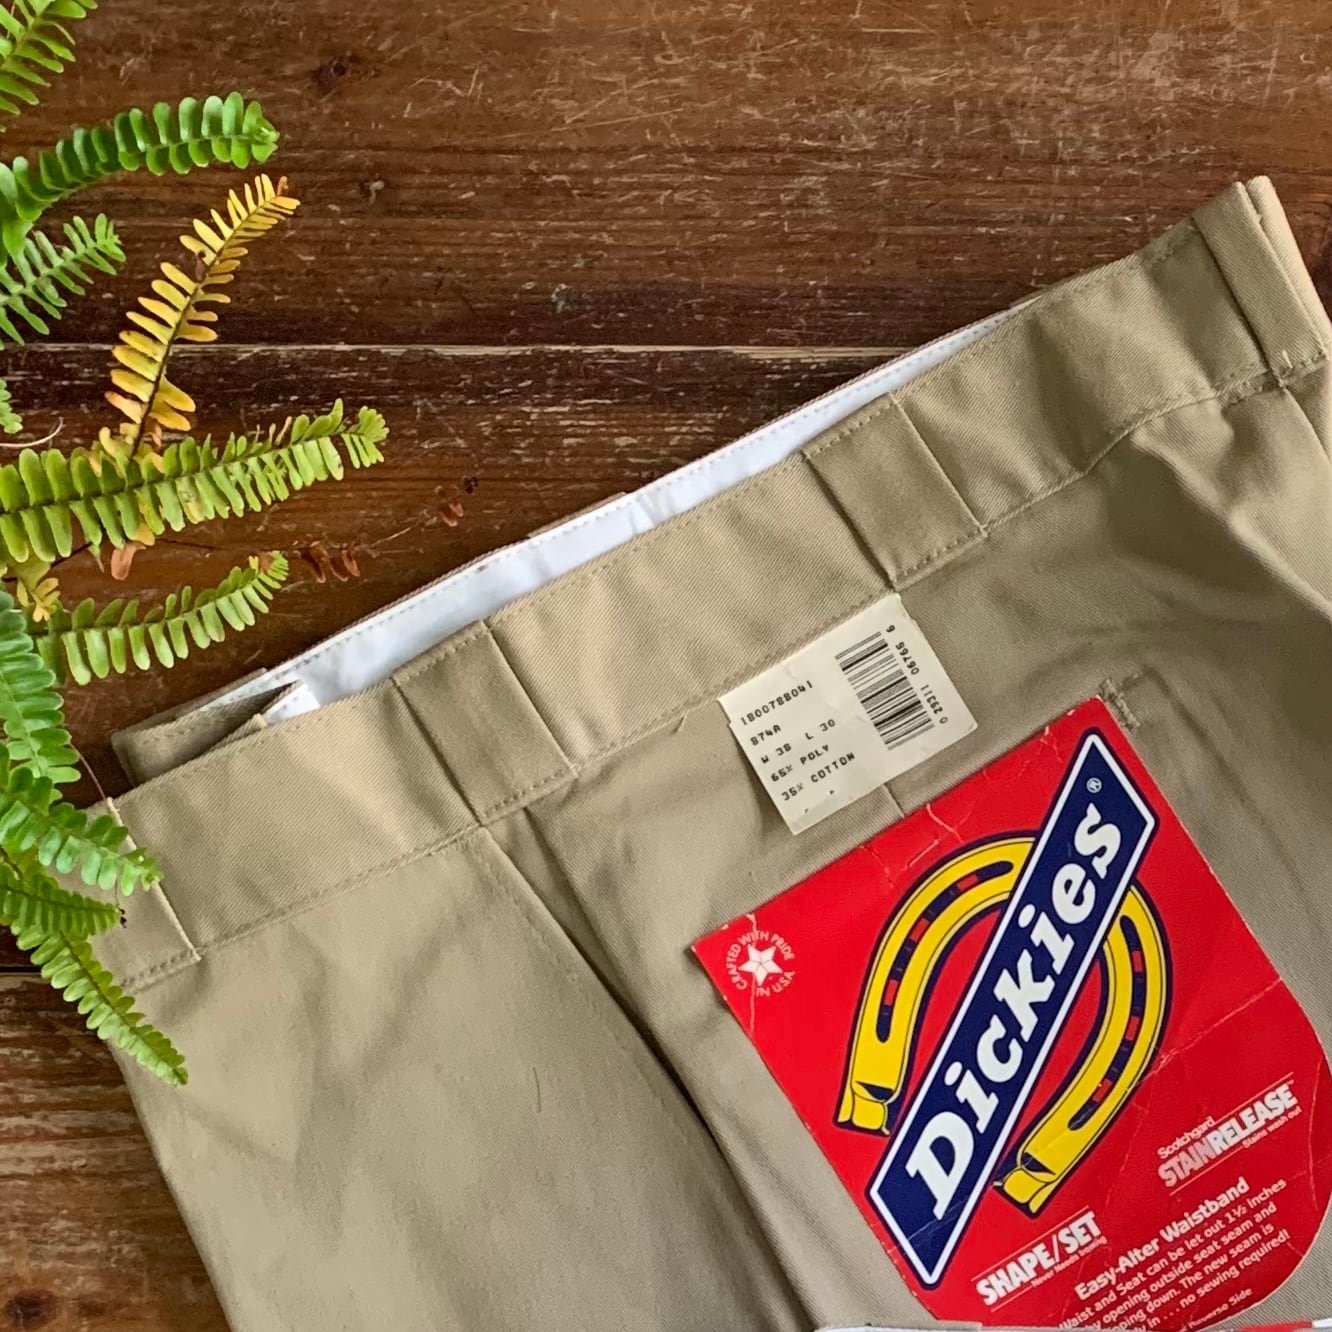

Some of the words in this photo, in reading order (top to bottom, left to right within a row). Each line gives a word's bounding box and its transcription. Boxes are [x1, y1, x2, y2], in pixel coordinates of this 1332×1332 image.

[920, 684, 944, 715] 29311
[938, 715, 948, 725] 0
[750, 724, 782, 747] 874A
[760, 754, 770, 765] W
[775, 742, 792, 758] 38
[804, 732, 814, 742] L
[820, 718, 836, 733] 30
[770, 766, 794, 784] 65%
[800, 744, 830, 766] POLY
[782, 782, 804, 802] 35%
[810, 751, 856, 784] COTTON
[726, 944, 748, 990] CRAFTED
[770, 933, 796, 960] PRIDE
[756, 986, 771, 998] IN
[771, 970, 796, 993] USA
[905, 802, 1122, 1220] Dickies
[1157, 1115, 1216, 1160] Scotchgard
[1242, 1129, 1268, 1149] Stains
[1288, 1106, 1302, 1119] out
[976, 1210, 1101, 1306] SHAPE/SET
[1074, 1238, 1160, 1301] Easy-Alter
[1160, 1176, 1250, 1244] Waistband
[1094, 1290, 1118, 1312] and
[1116, 1272, 1146, 1297] Seat
[1146, 1258, 1170, 1277] can
[1168, 1246, 1186, 1262] be
[1186, 1234, 1206, 1251] let
[1203, 1218, 1226, 1241] out
[1247, 1178, 1288, 1210] inches
[1054, 1254, 1080, 1273] Needs
[1102, 1290, 1152, 1326] opening
[1149, 1258, 1194, 1292] outside
[1193, 1240, 1222, 1264] seat
[1221, 1220, 1254, 1246] seam
[1253, 1201, 1278, 1224] and
[1145, 1290, 1181, 1314] down.
[1179, 1272, 1204, 1291] The
[1202, 1254, 1229, 1276] new
[1228, 1232, 1262, 1258] seam
[1262, 1222, 1276, 1236] is
[1147, 1315, 1161, 1328] in
[1179, 1292, 1196, 1310] no
[1196, 1266, 1240, 1299] sewing
[1238, 1228, 1290, 1271] required!
[1228, 1286, 1254, 1306] Side
